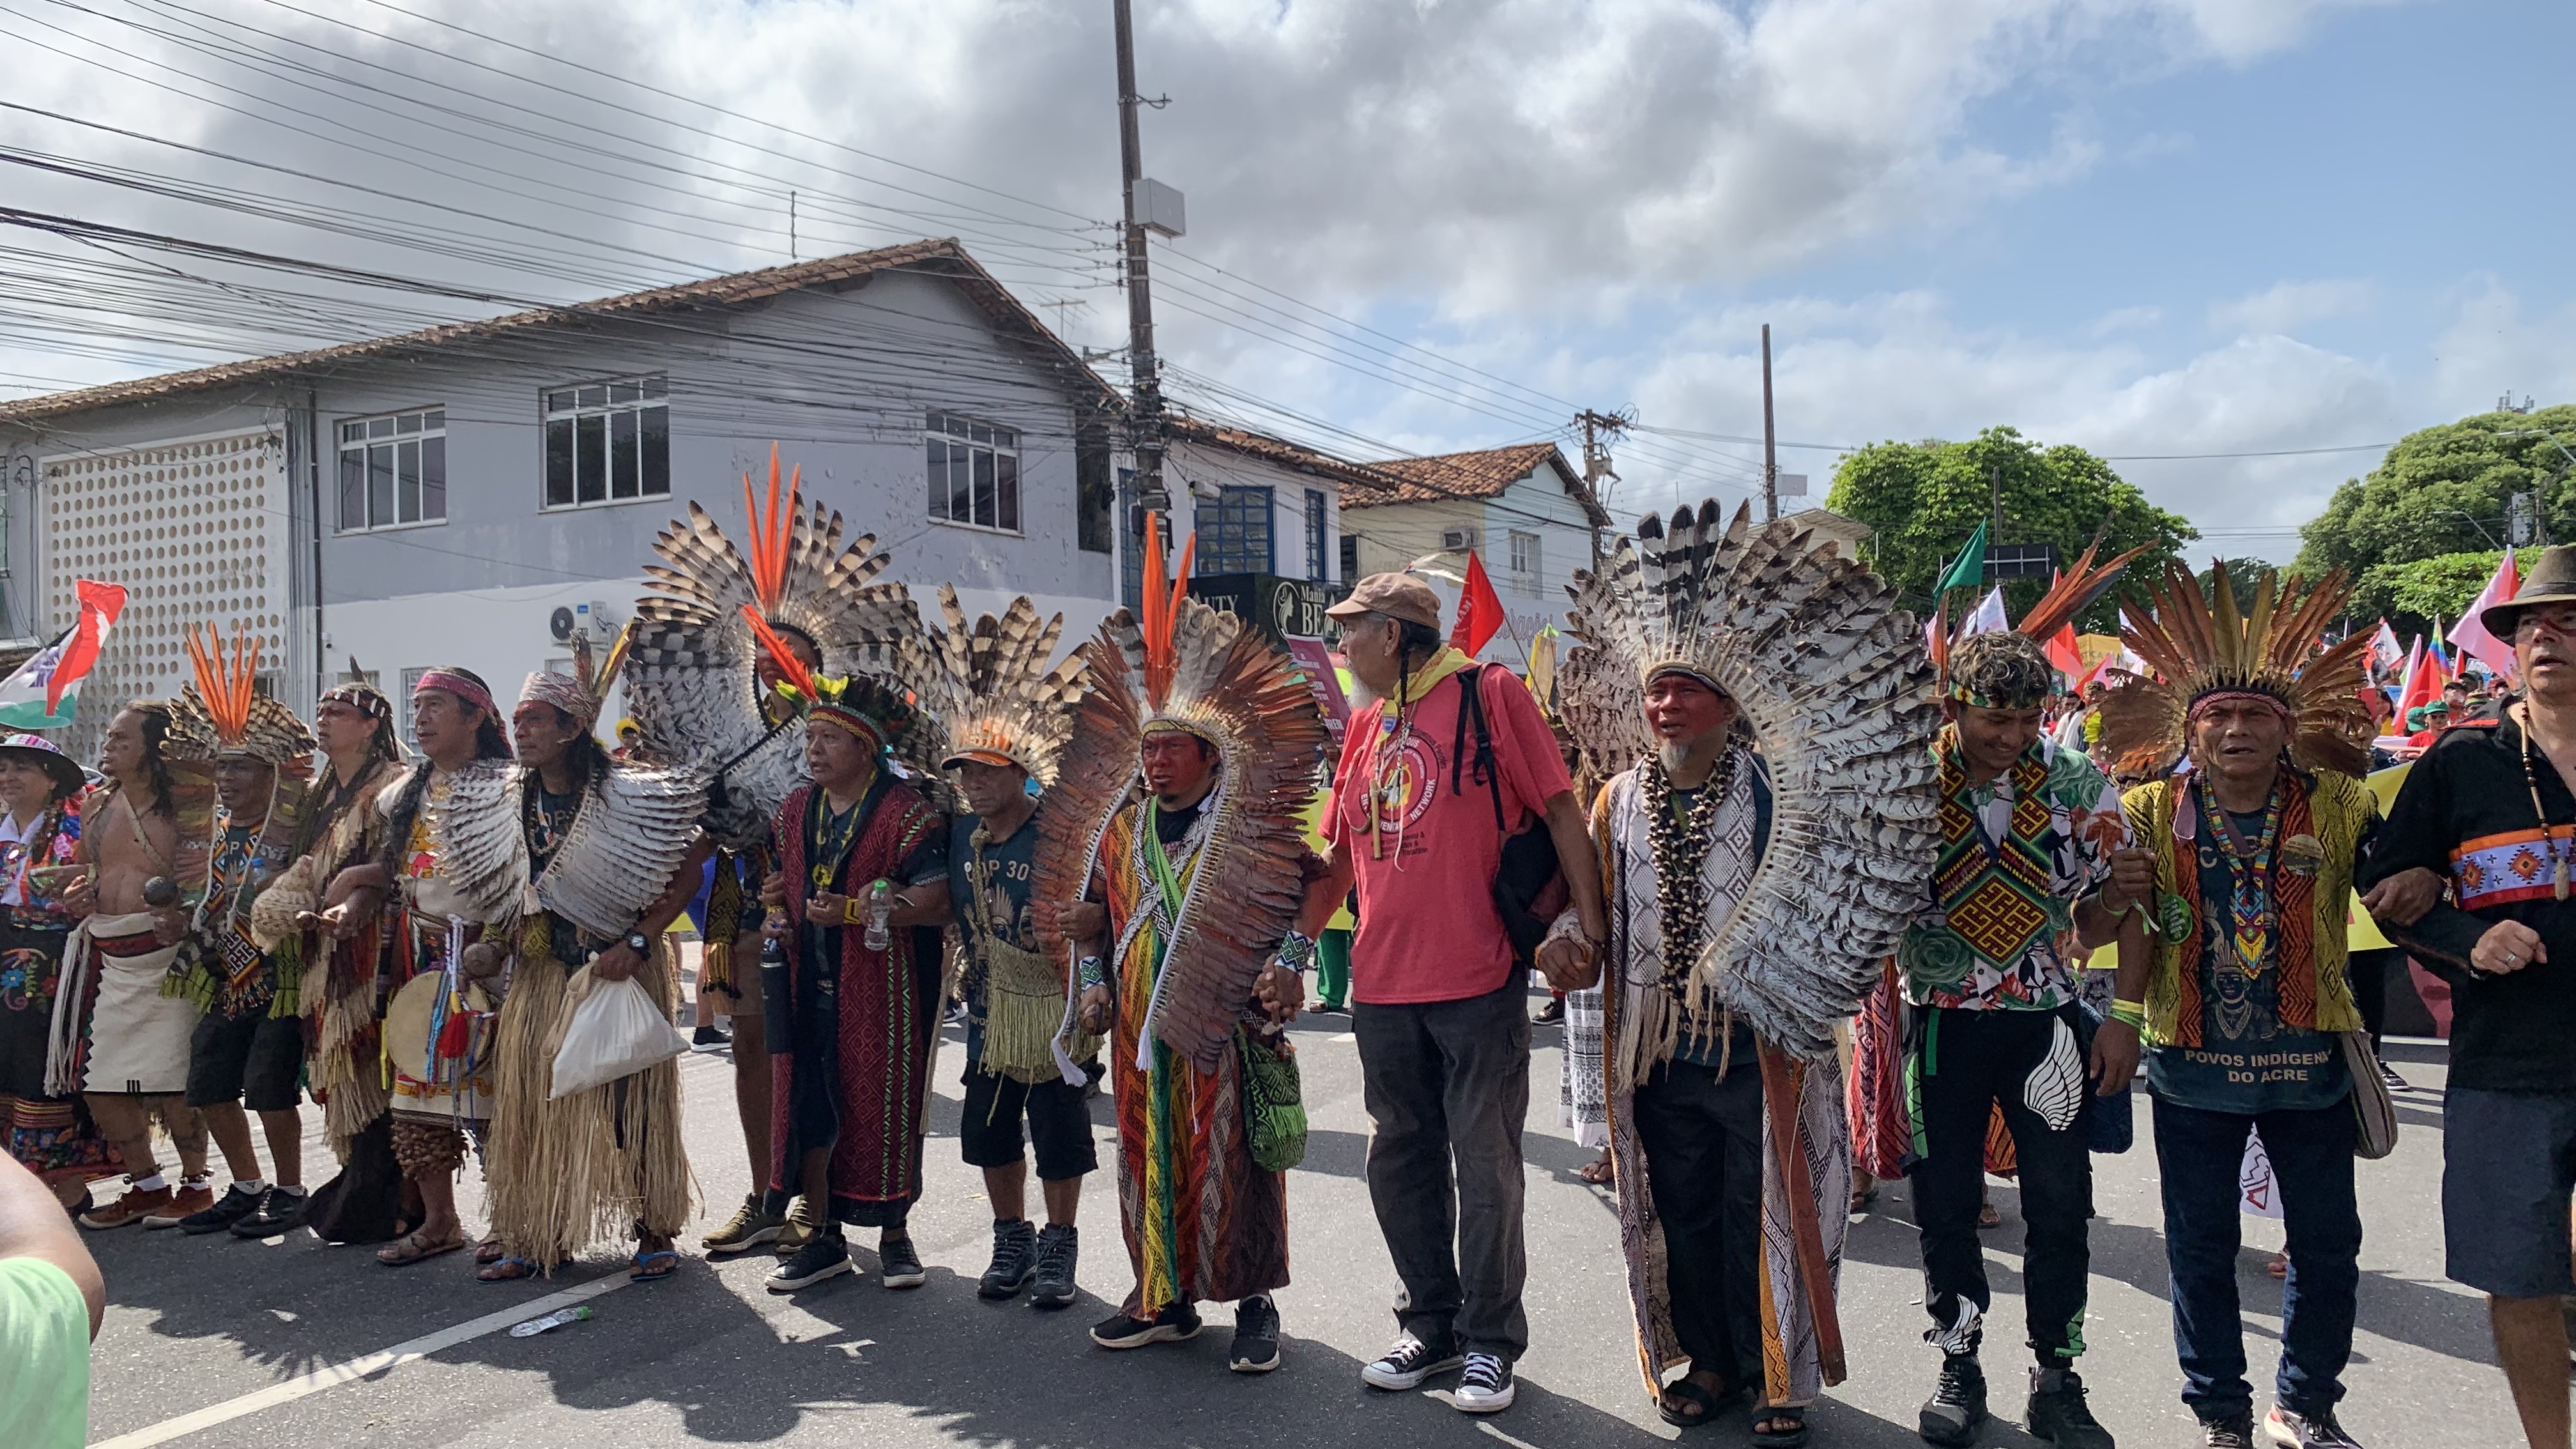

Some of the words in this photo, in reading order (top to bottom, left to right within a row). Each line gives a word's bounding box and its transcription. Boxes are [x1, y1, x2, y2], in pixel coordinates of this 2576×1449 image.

[1301, 585, 1326, 604] Mania
[1409, 779, 1436, 821] NETWORK
[1006, 860, 1030, 881] 30
[2185, 1050, 2244, 1067] POVOS
[2251, 1048, 2332, 1068] INDÍGENA
[2228, 1070, 2255, 1083] DO
[2260, 1069, 2308, 1083] ACRE
